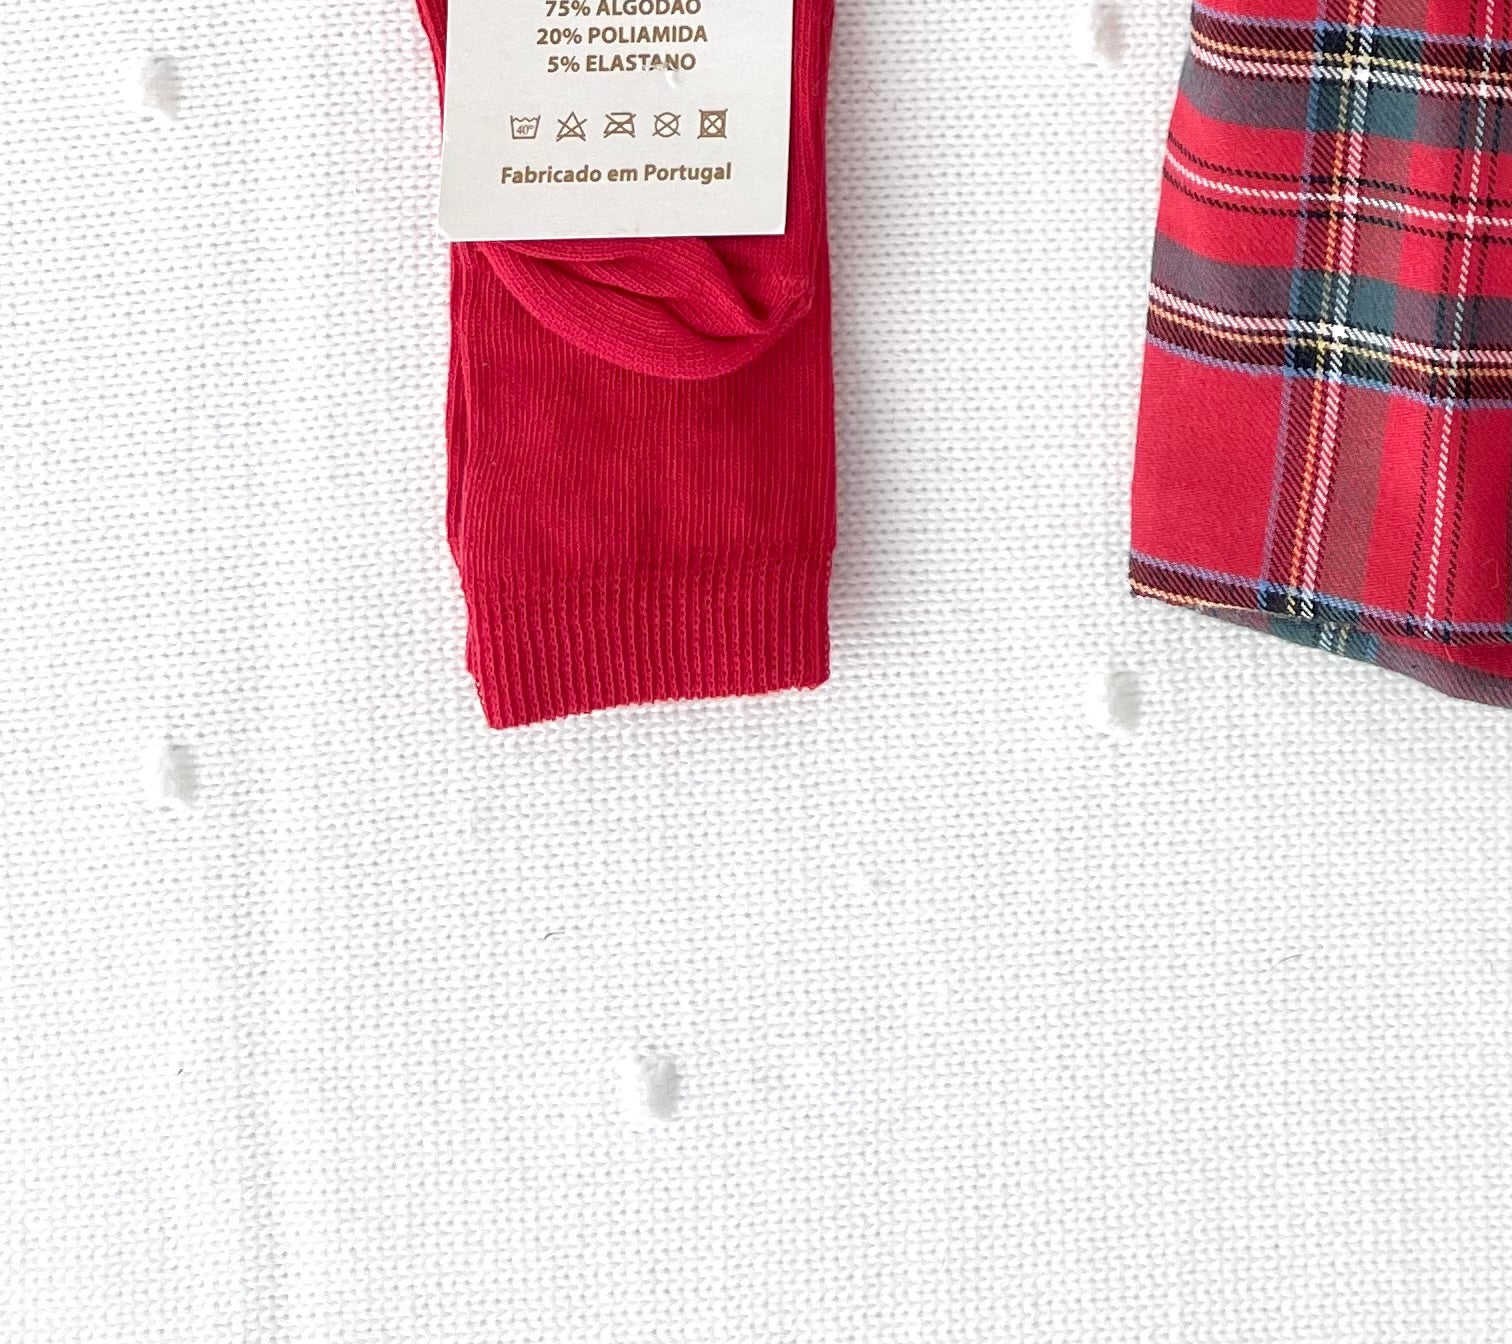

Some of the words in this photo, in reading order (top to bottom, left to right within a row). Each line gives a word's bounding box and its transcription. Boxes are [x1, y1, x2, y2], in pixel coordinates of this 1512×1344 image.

[545, 0, 591, 17] 75%
[536, 27, 583, 45] 20%
[587, 25, 708, 44] POLIAMIDA
[547, 55, 581, 73] 5%
[585, 52, 697, 73] ELASTANO
[500, 166, 602, 185] Fabricado
[607, 168, 639, 182] em
[643, 161, 733, 185] Portugal
